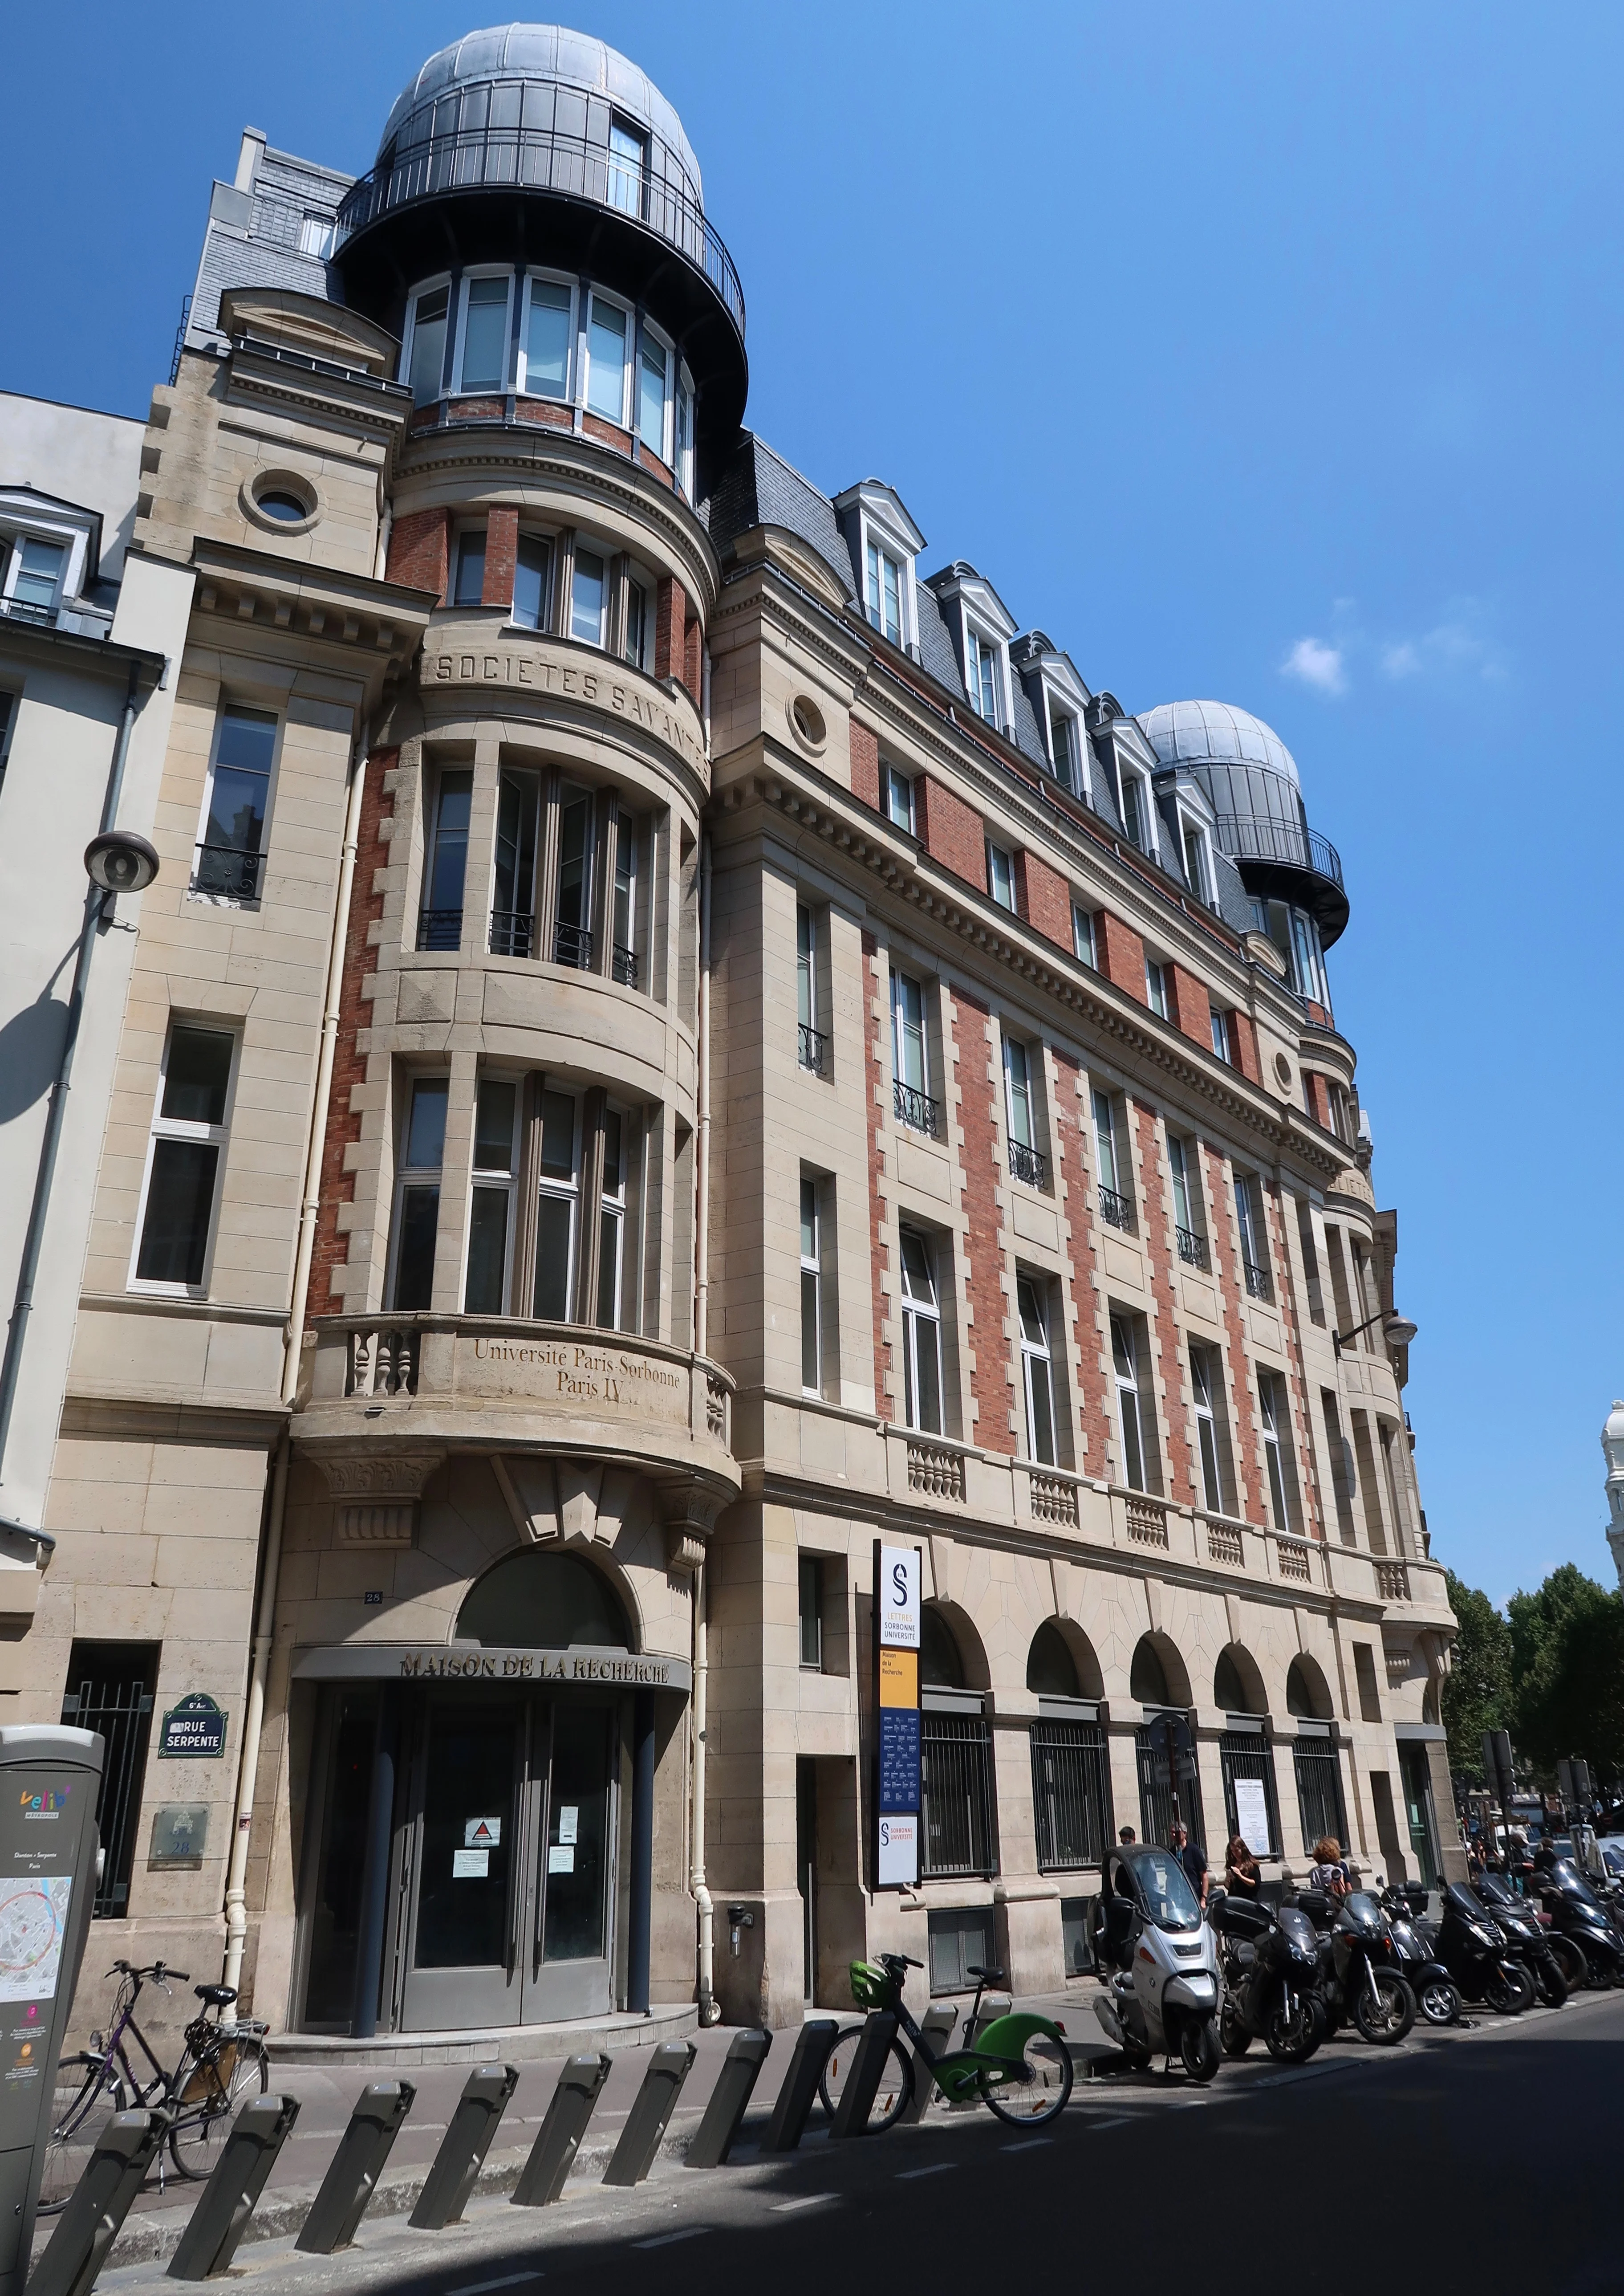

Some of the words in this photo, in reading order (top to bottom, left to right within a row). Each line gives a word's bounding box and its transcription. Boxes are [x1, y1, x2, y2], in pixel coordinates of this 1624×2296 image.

[436, 656, 597, 700] SOCIETES
[612, 686, 707, 782] SAVANTES
[474, 1339, 567, 1366] Université
[573, 1347, 680, 1389] Paris-Sorbonne
[556, 1371, 598, 1396] Paris
[603, 1378, 624, 1403] IV
[367, 1593, 380, 1602] 28
[887, 1612, 913, 1622] LETTRES
[885, 1621, 915, 1632] SORBONNE
[885, 1630, 915, 1641] UNIVERSITÉ
[400, 1652, 498, 1676] MAISON
[502, 1653, 535, 1677] DE
[540, 1655, 567, 1678] LA
[572, 1656, 670, 1683] RECHERCHE
[882, 1668, 903, 1676] Recherche
[184, 1721, 207, 1732] RUE
[166, 1735, 219, 1747] SERPENTE
[171, 1841, 189, 1855] 28
